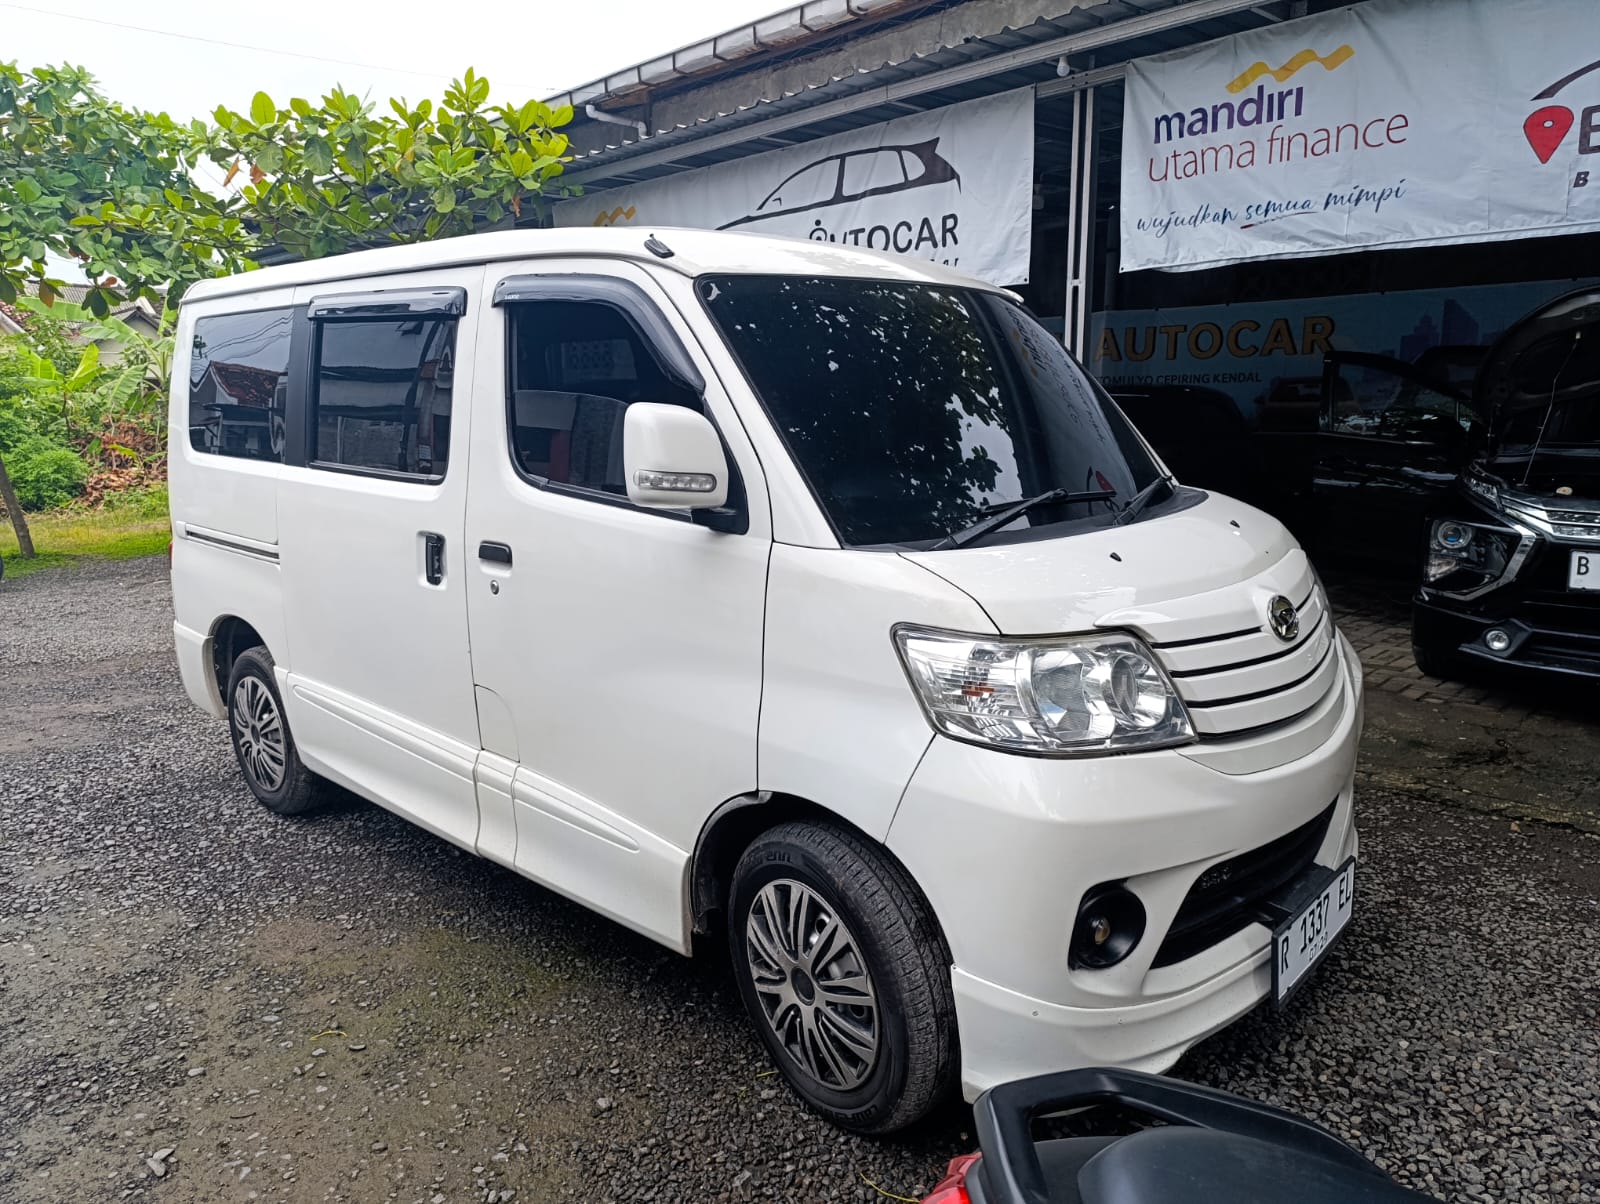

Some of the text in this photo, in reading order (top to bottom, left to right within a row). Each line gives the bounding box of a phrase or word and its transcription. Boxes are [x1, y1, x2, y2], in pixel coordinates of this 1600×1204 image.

[1153, 84, 1304, 144] mandiri
[1148, 111, 1410, 183] utama finance
[1136, 179, 1408, 238] wujudkan semua mimpi
[1094, 315, 1335, 362] AUTOCAR
[1155, 373, 1210, 386] CEPIRING
[1213, 371, 1262, 384] KENDAL
[1576, 556, 1590, 576] B
[1281, 873, 1351, 975] R 1337 EL
